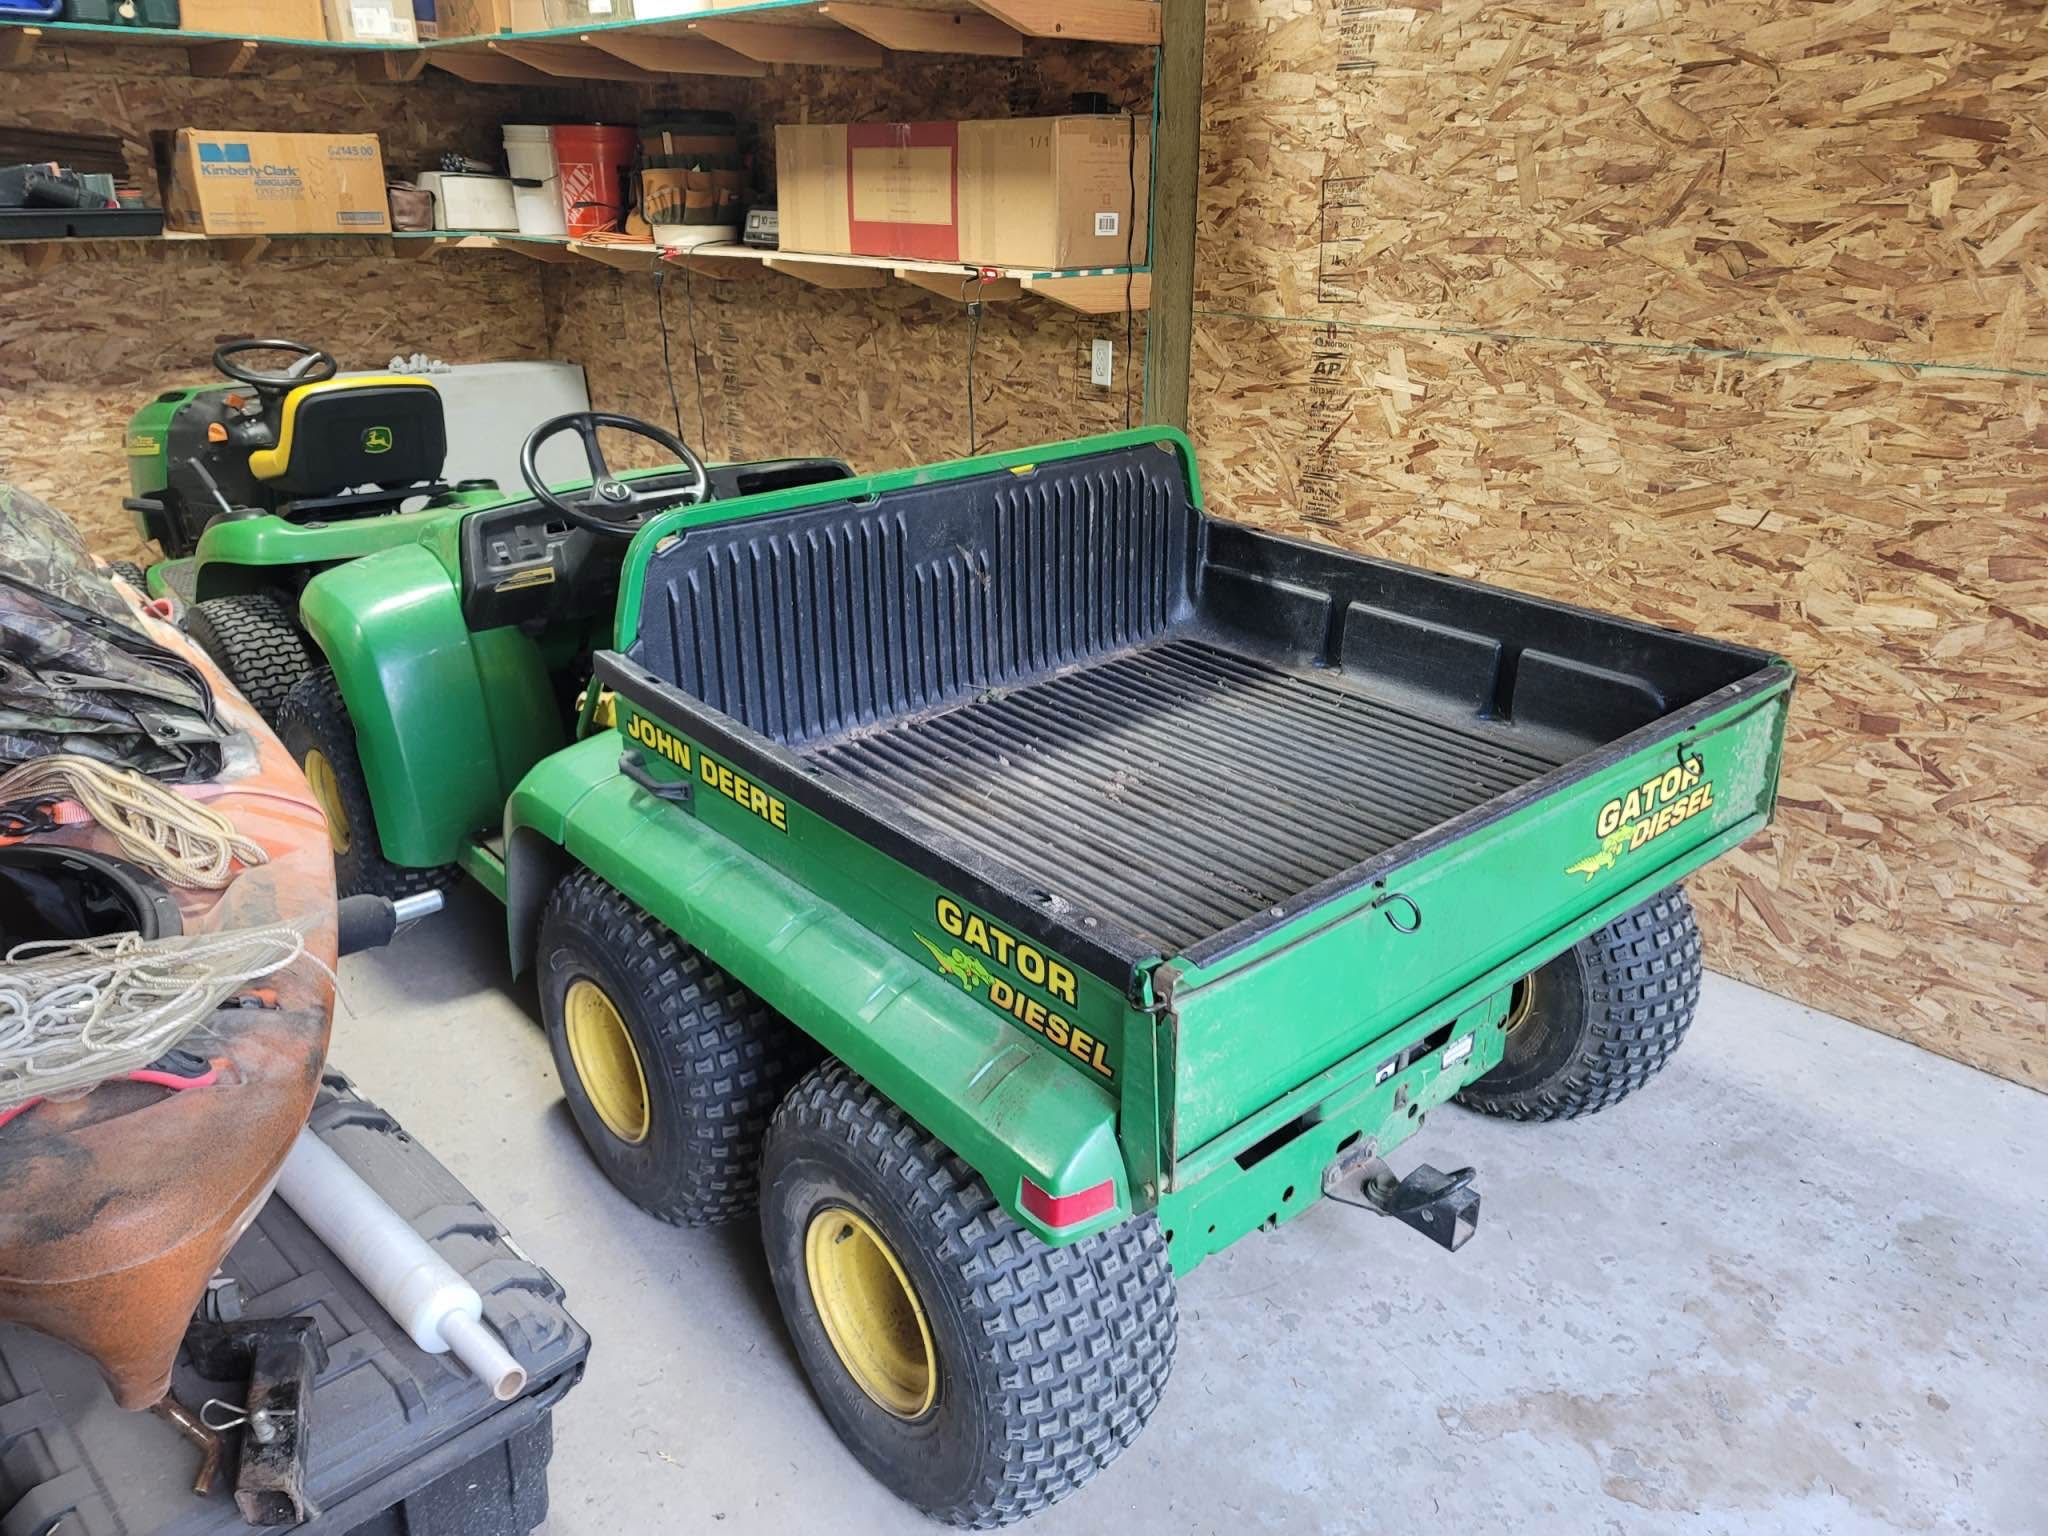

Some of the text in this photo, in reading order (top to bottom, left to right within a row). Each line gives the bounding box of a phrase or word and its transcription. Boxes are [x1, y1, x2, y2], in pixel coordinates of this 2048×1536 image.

[202, 164, 297, 176] Kimberly-Clark
[627, 712, 788, 834] JOHN DEERE
[1596, 757, 1701, 838] GATOR
[1629, 780, 1714, 852] DIESEL
[936, 896, 1078, 1009] GATOR
[988, 977, 1115, 1080] DIESEL
